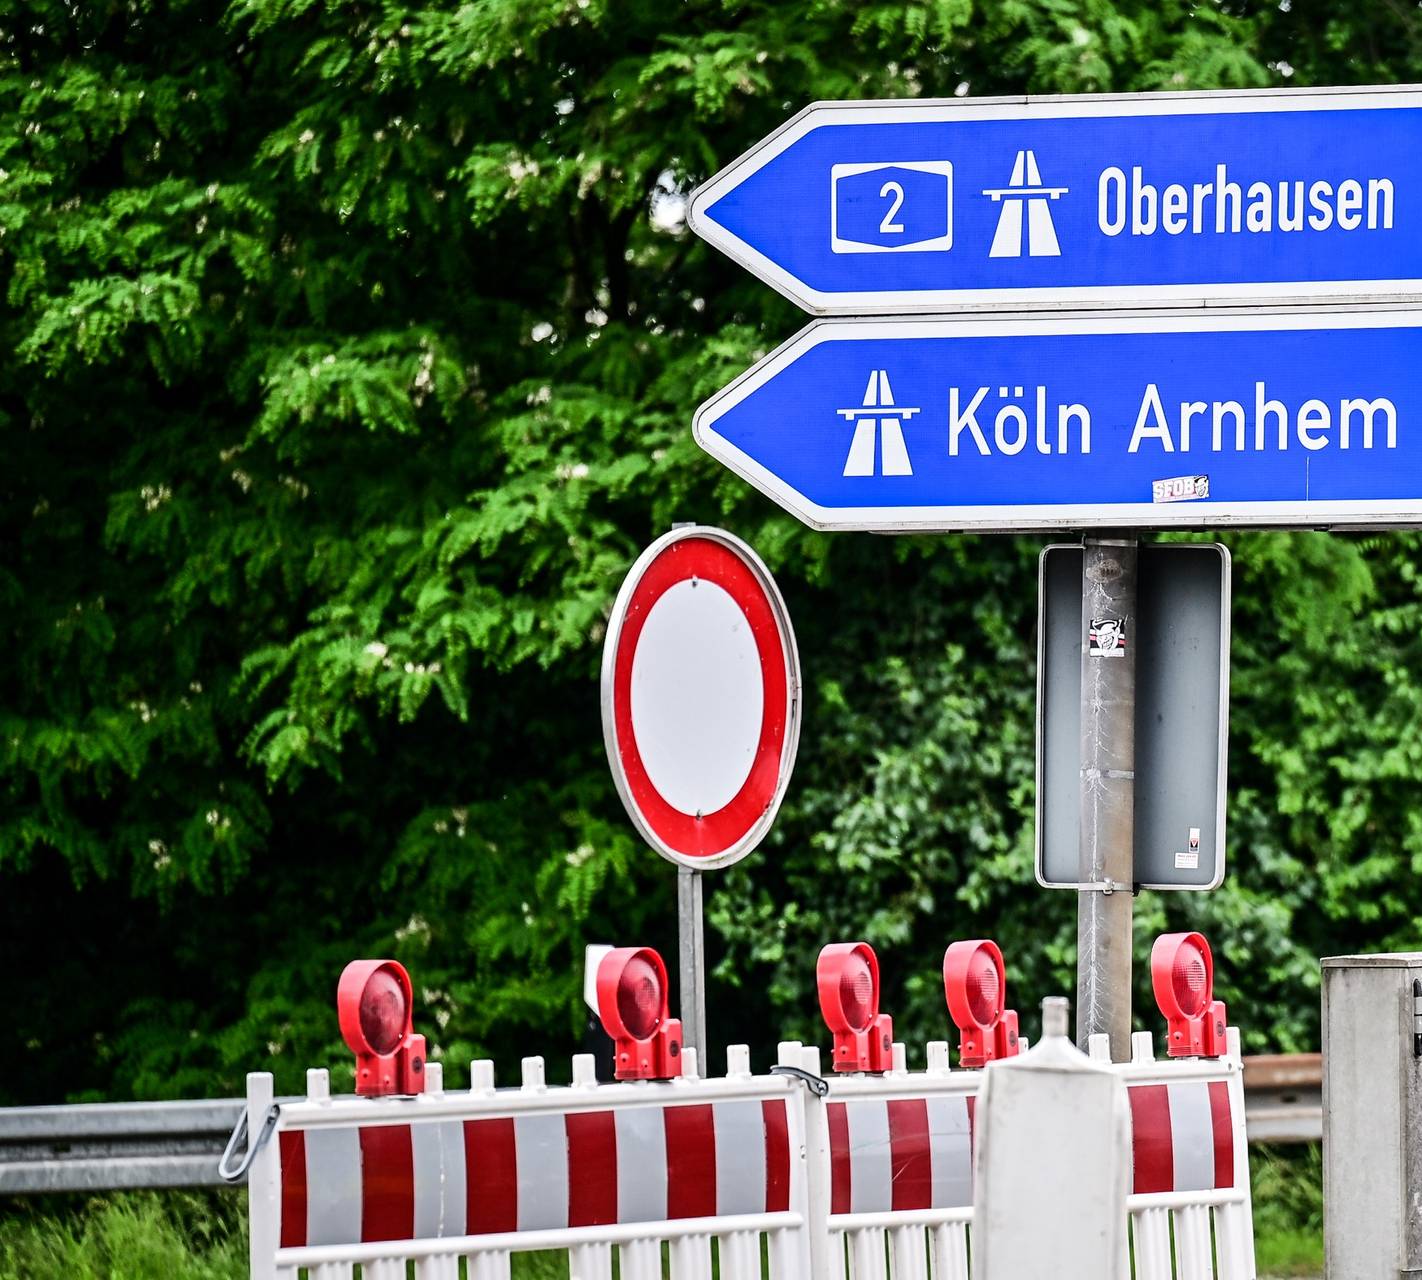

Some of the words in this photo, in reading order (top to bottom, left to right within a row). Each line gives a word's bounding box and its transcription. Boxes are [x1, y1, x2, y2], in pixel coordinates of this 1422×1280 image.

[879, 181, 904, 233] 2
[1098, 164, 1394, 237] Oberhausen
[948, 384, 1091, 456] Köln
[1127, 381, 1397, 453] Arnhem
